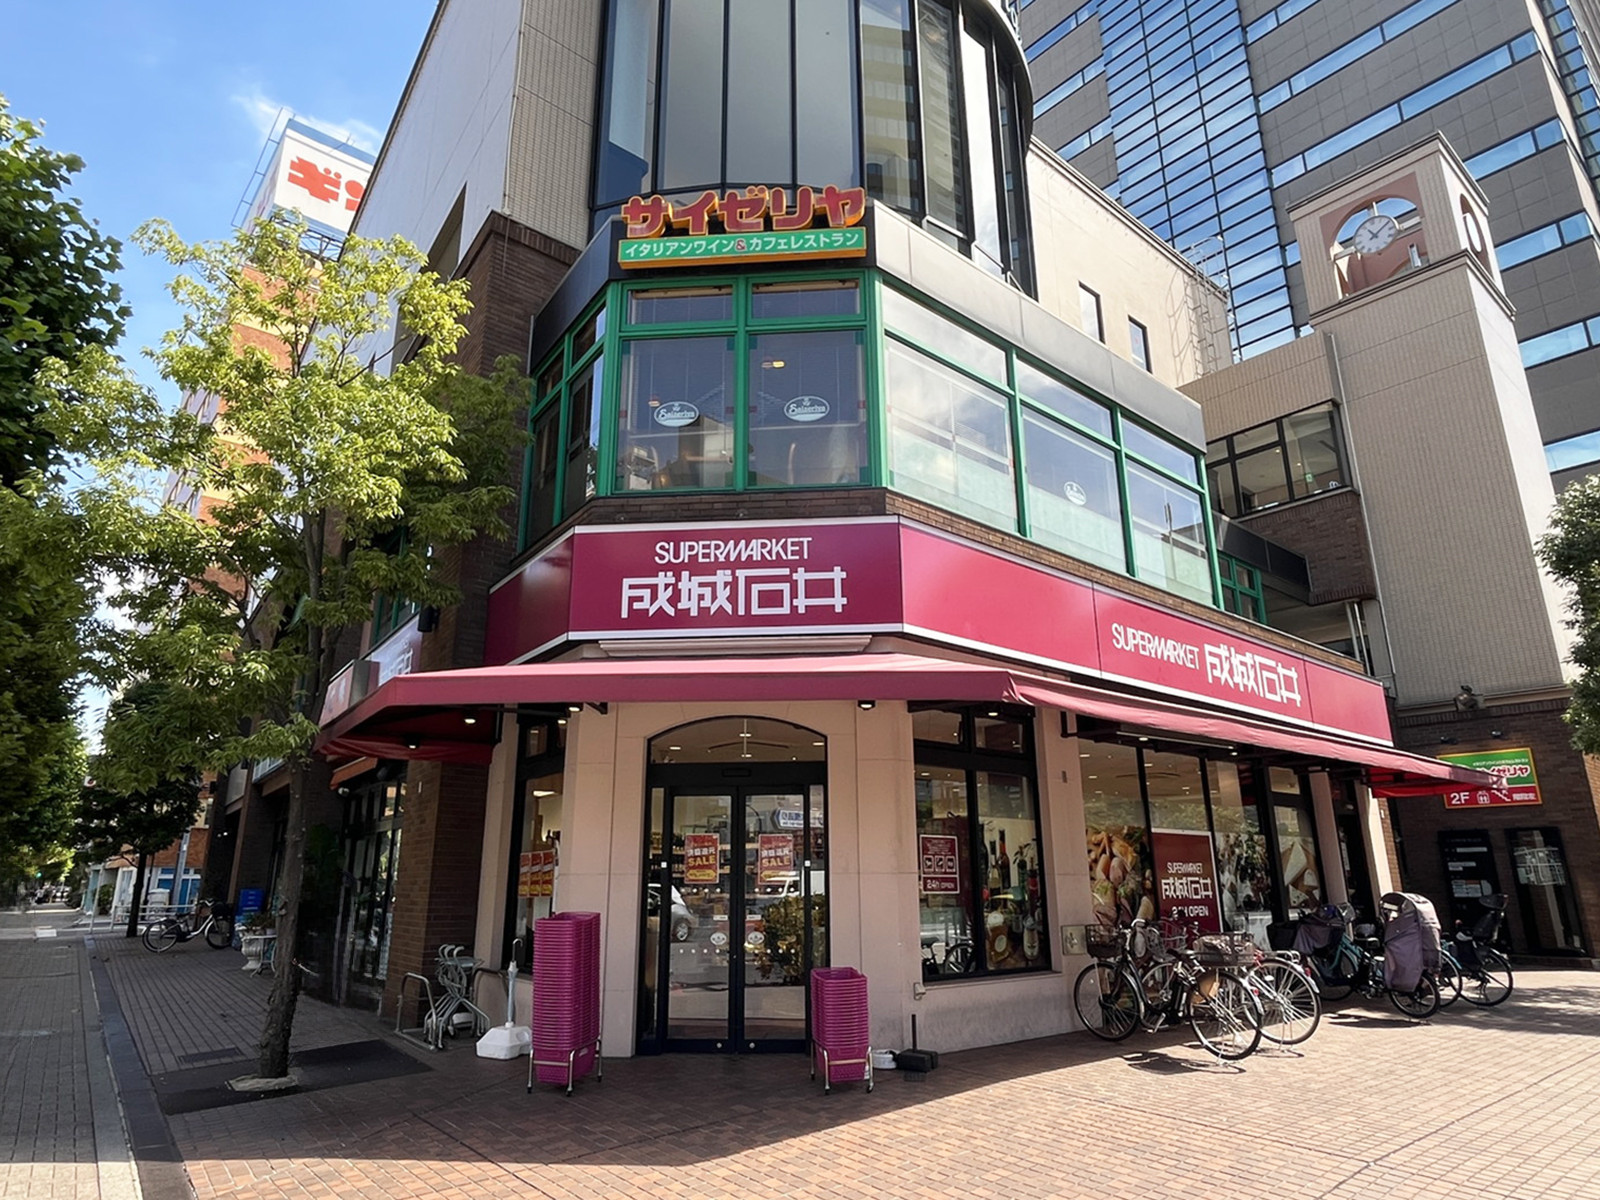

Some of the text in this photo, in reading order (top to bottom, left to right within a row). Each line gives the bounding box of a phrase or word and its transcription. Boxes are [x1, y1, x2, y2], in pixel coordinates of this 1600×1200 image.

[621, 185, 866, 239] サイゼリヤ
[625, 232, 860, 258] イタリアンワイン&カフェレストラン
[654, 537, 812, 564] SUPERMARKET
[620, 565, 848, 619] 成城石井
[1111, 622, 1302, 708] SUPERMARKET 成城石井
[1450, 791, 1470, 805] 2F
[688, 855, 716, 867] SALE
[761, 856, 790, 867] SALE
[1167, 862, 1202, 873] SUPERMARKET
[1161, 877, 1212, 899] 成城石井
[1188, 906, 1208, 916] OPEN
